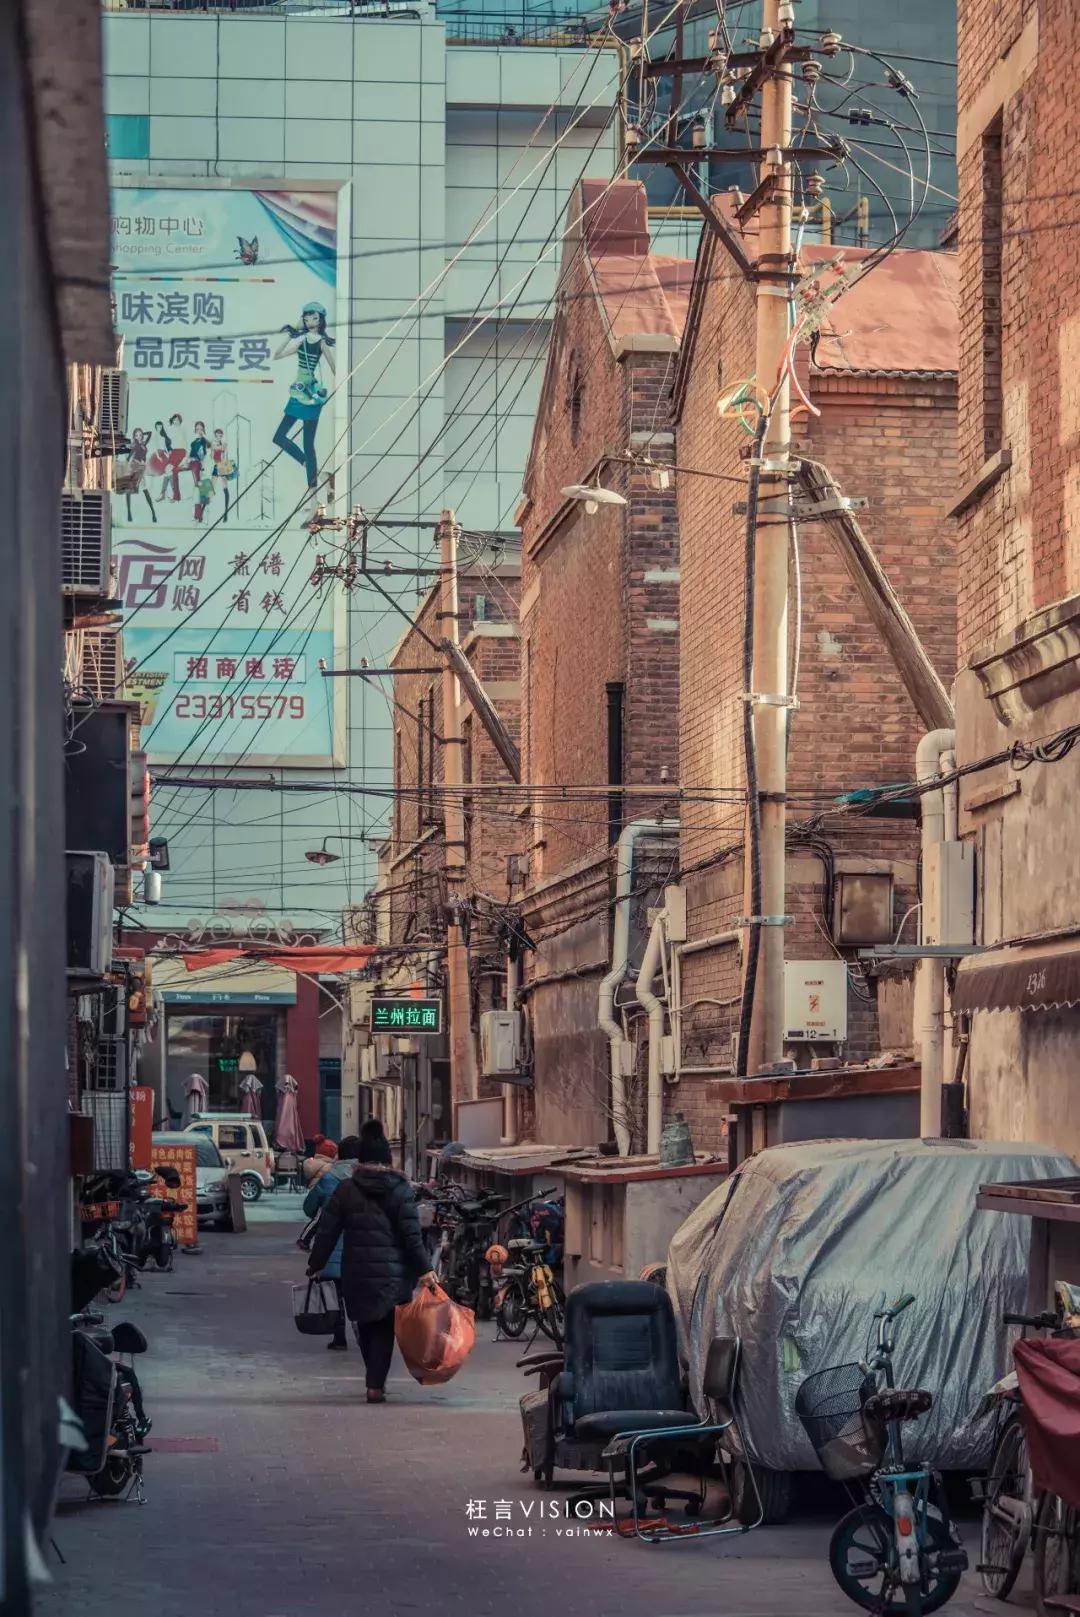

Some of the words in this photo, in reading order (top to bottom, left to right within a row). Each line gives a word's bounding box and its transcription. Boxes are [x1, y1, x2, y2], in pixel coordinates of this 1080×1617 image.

[121, 291, 224, 325] 味滨购
[133, 336, 271, 371] 品质享受
[187, 656, 295, 680] 招商电话
[175, 694, 304, 719] 23315579
[374, 1007, 437, 1026] 兰州拉面
